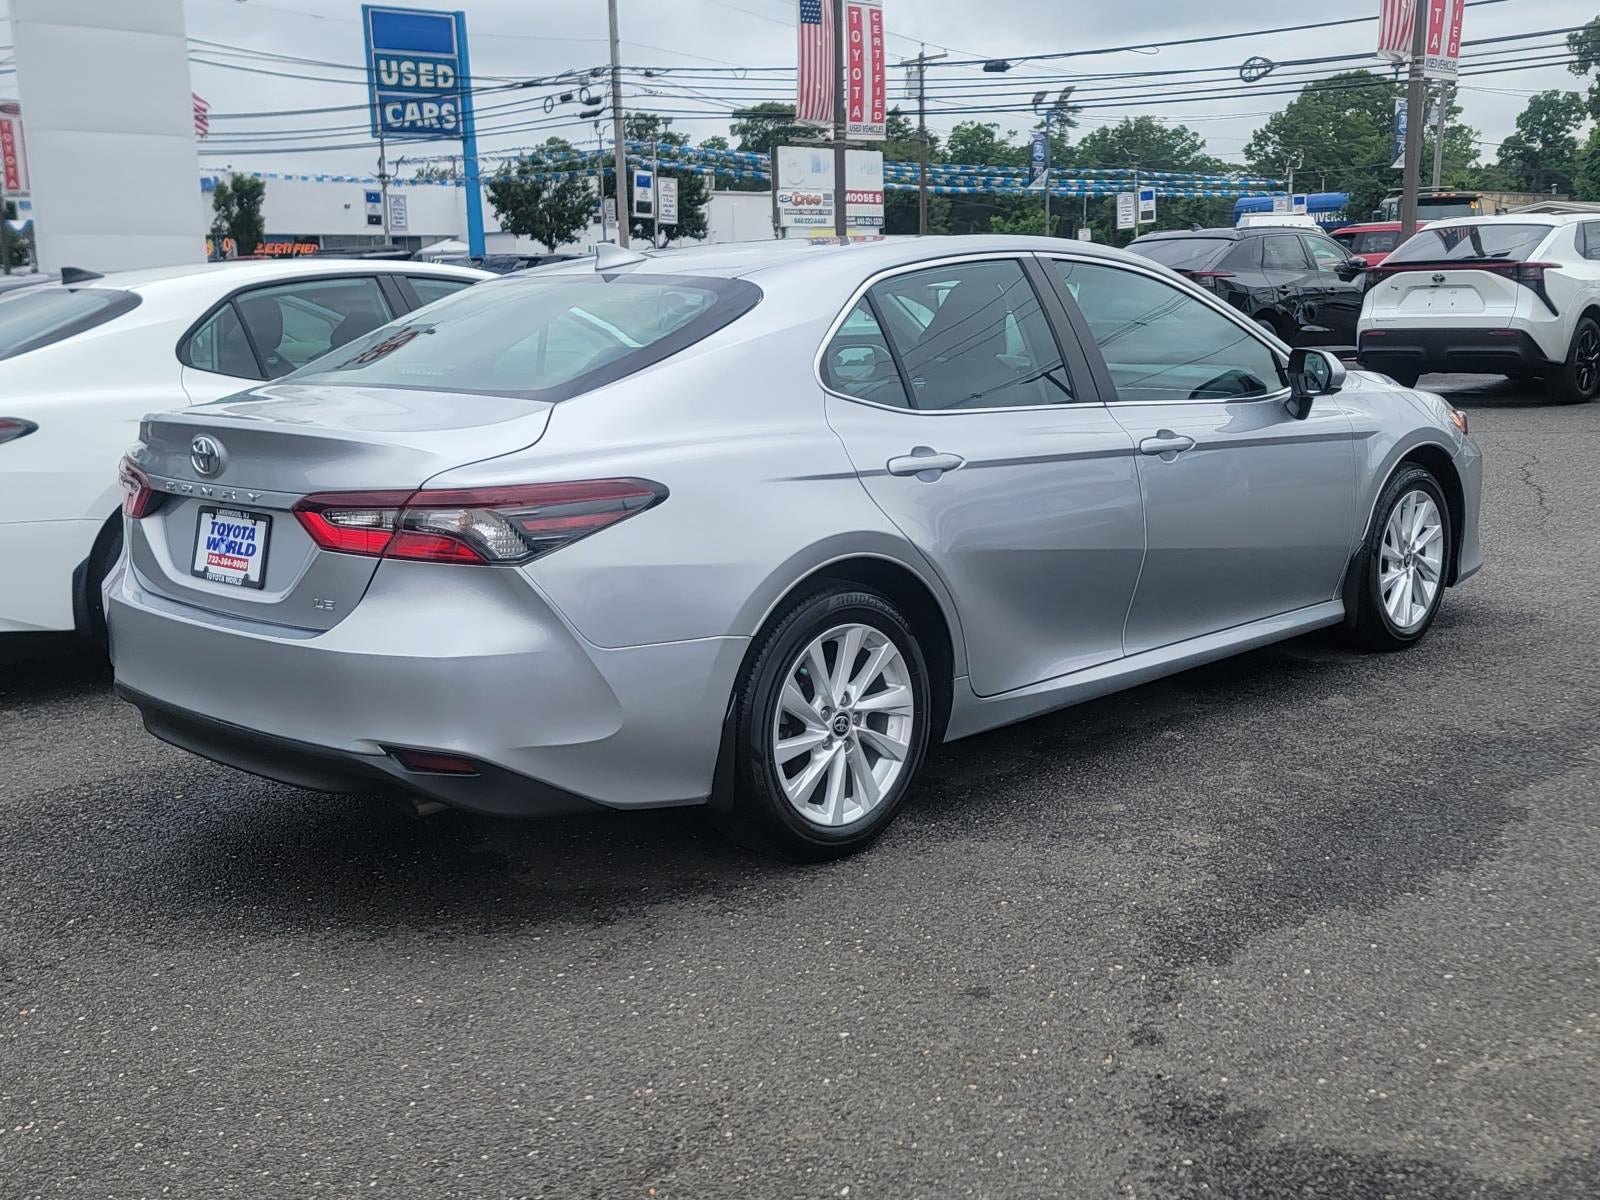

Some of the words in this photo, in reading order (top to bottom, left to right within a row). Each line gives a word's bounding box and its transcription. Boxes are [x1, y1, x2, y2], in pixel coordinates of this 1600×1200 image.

[379, 59, 455, 88] USED
[850, 11, 861, 118] TOYOTA
[872, 12, 883, 120] CERTIFIED
[385, 101, 457, 129] CARS
[164, 481, 263, 502] CAMRY
[210, 521, 256, 541] TOYOTA
[206, 536, 257, 557] WORLD
[206, 572, 225, 582] TOYOTA
[225, 576, 243, 586] WORLD
[313, 599, 335, 611] LE
